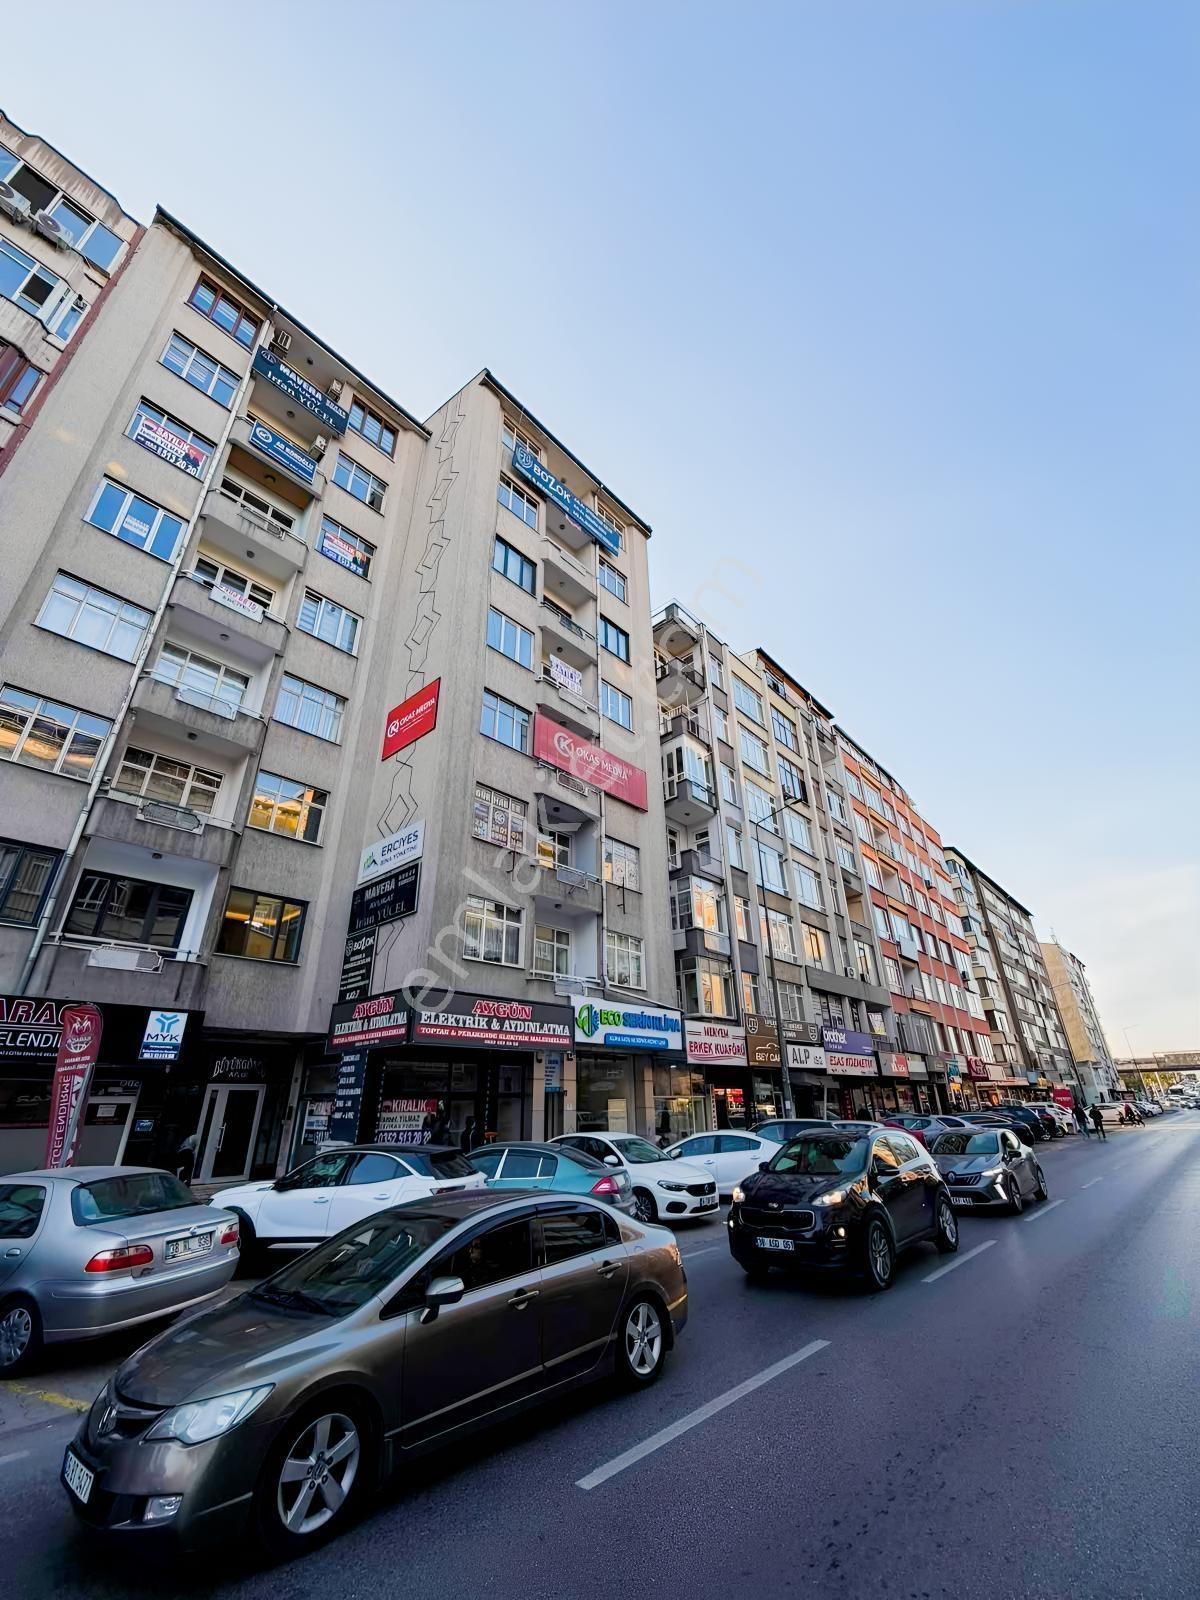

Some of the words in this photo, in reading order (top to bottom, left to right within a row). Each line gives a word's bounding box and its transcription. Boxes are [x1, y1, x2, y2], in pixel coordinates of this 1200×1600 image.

[533, 463, 571, 504] BOZOK
[576, 747, 600, 766] OKAS
[602, 760, 629, 781] MEDYA
[0, 998, 65, 1025] RA
[472, 999, 533, 1020] AYGÜN
[600, 1008, 621, 1027] ECO
[419, 1011, 490, 1029] ELEKTRİK
[491, 1018, 501, 1031] &
[503, 1018, 570, 1037] AYDINLATMA
[146, 1033, 180, 1042] MYK
[689, 1040, 713, 1054] ERKEK
[792, 1047, 810, 1065] ALP
[830, 1055, 844, 1067] ESAS
[392, 1099, 428, 1112] KIRALIK
